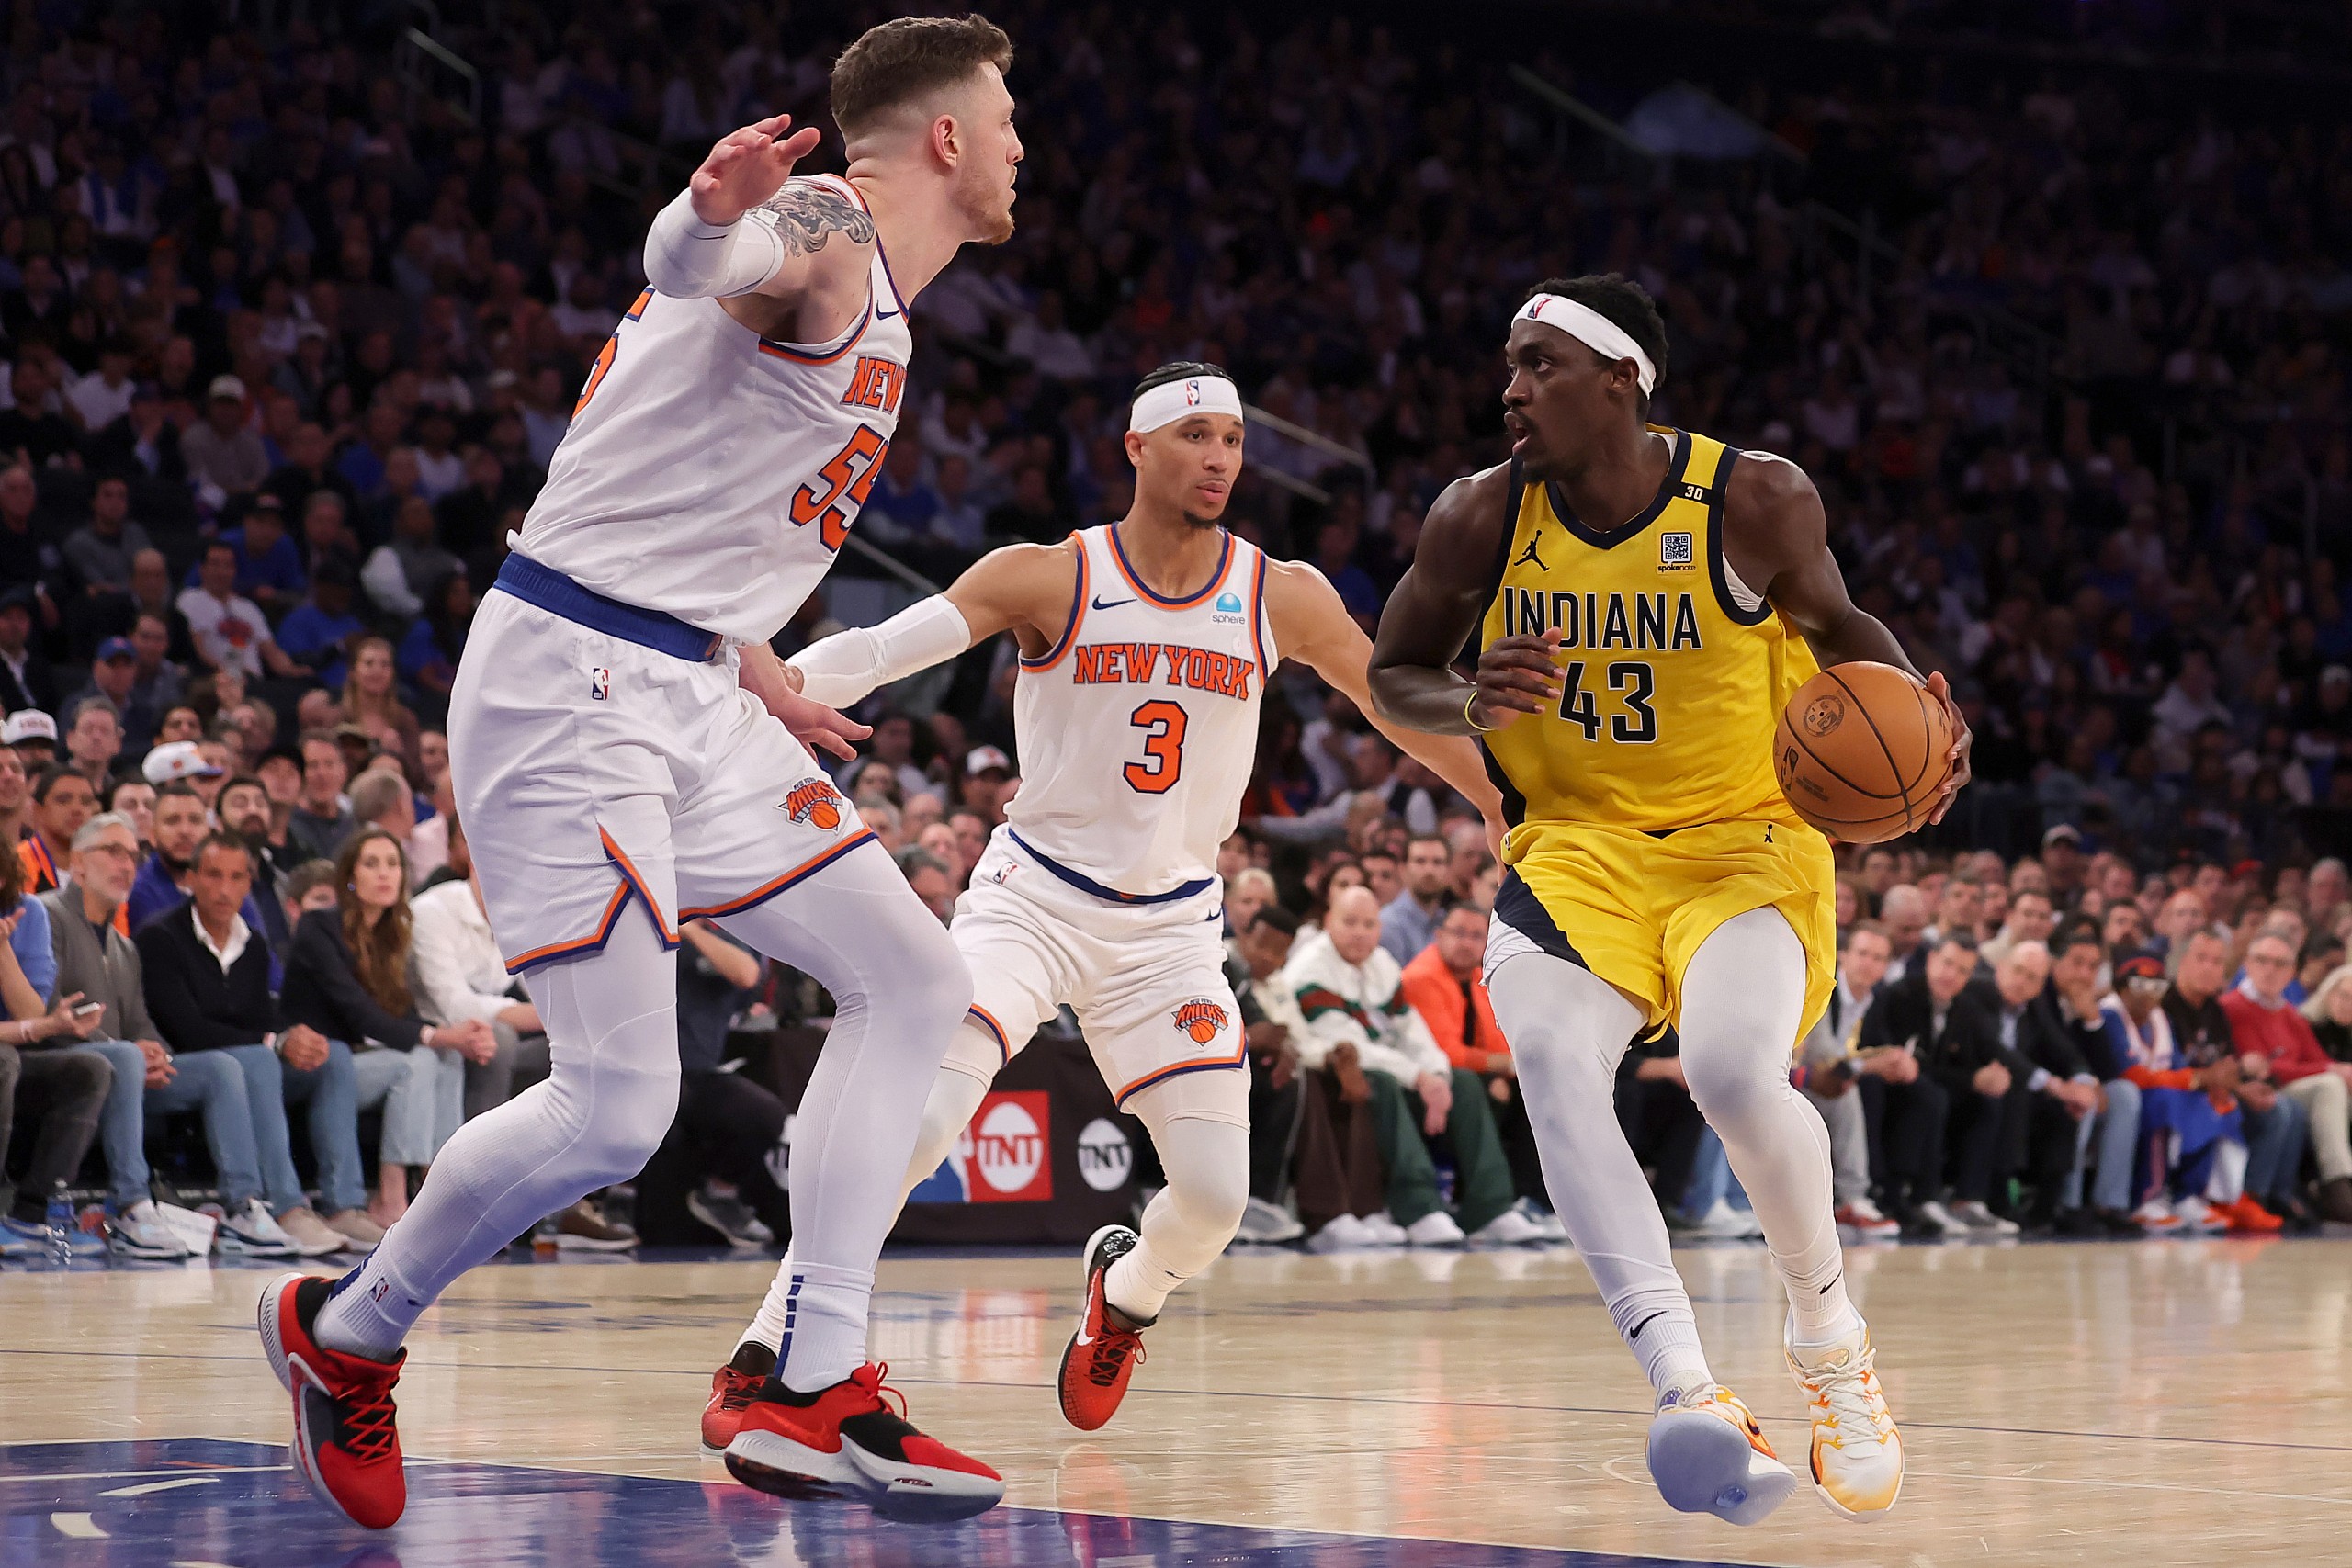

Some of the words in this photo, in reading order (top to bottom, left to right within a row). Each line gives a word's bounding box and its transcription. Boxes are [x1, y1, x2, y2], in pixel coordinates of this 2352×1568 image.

[840, 355, 902, 415] NEW
[1684, 485, 1703, 501] 30
[1657, 563, 1696, 573] spokenote
[1212, 614, 1246, 625] sphere
[1503, 586, 1702, 651] INDIANA
[1073, 642, 1159, 685] NEW
[1163, 644, 1255, 701] YORK
[1558, 661, 1658, 745] 43
[1123, 699, 1189, 795] 3
[786, 779, 842, 821] KNICKS
[1174, 1003, 1228, 1028] KNICKS
[978, 1134, 1041, 1168] TNT
[1079, 1144, 1129, 1169] TNT
